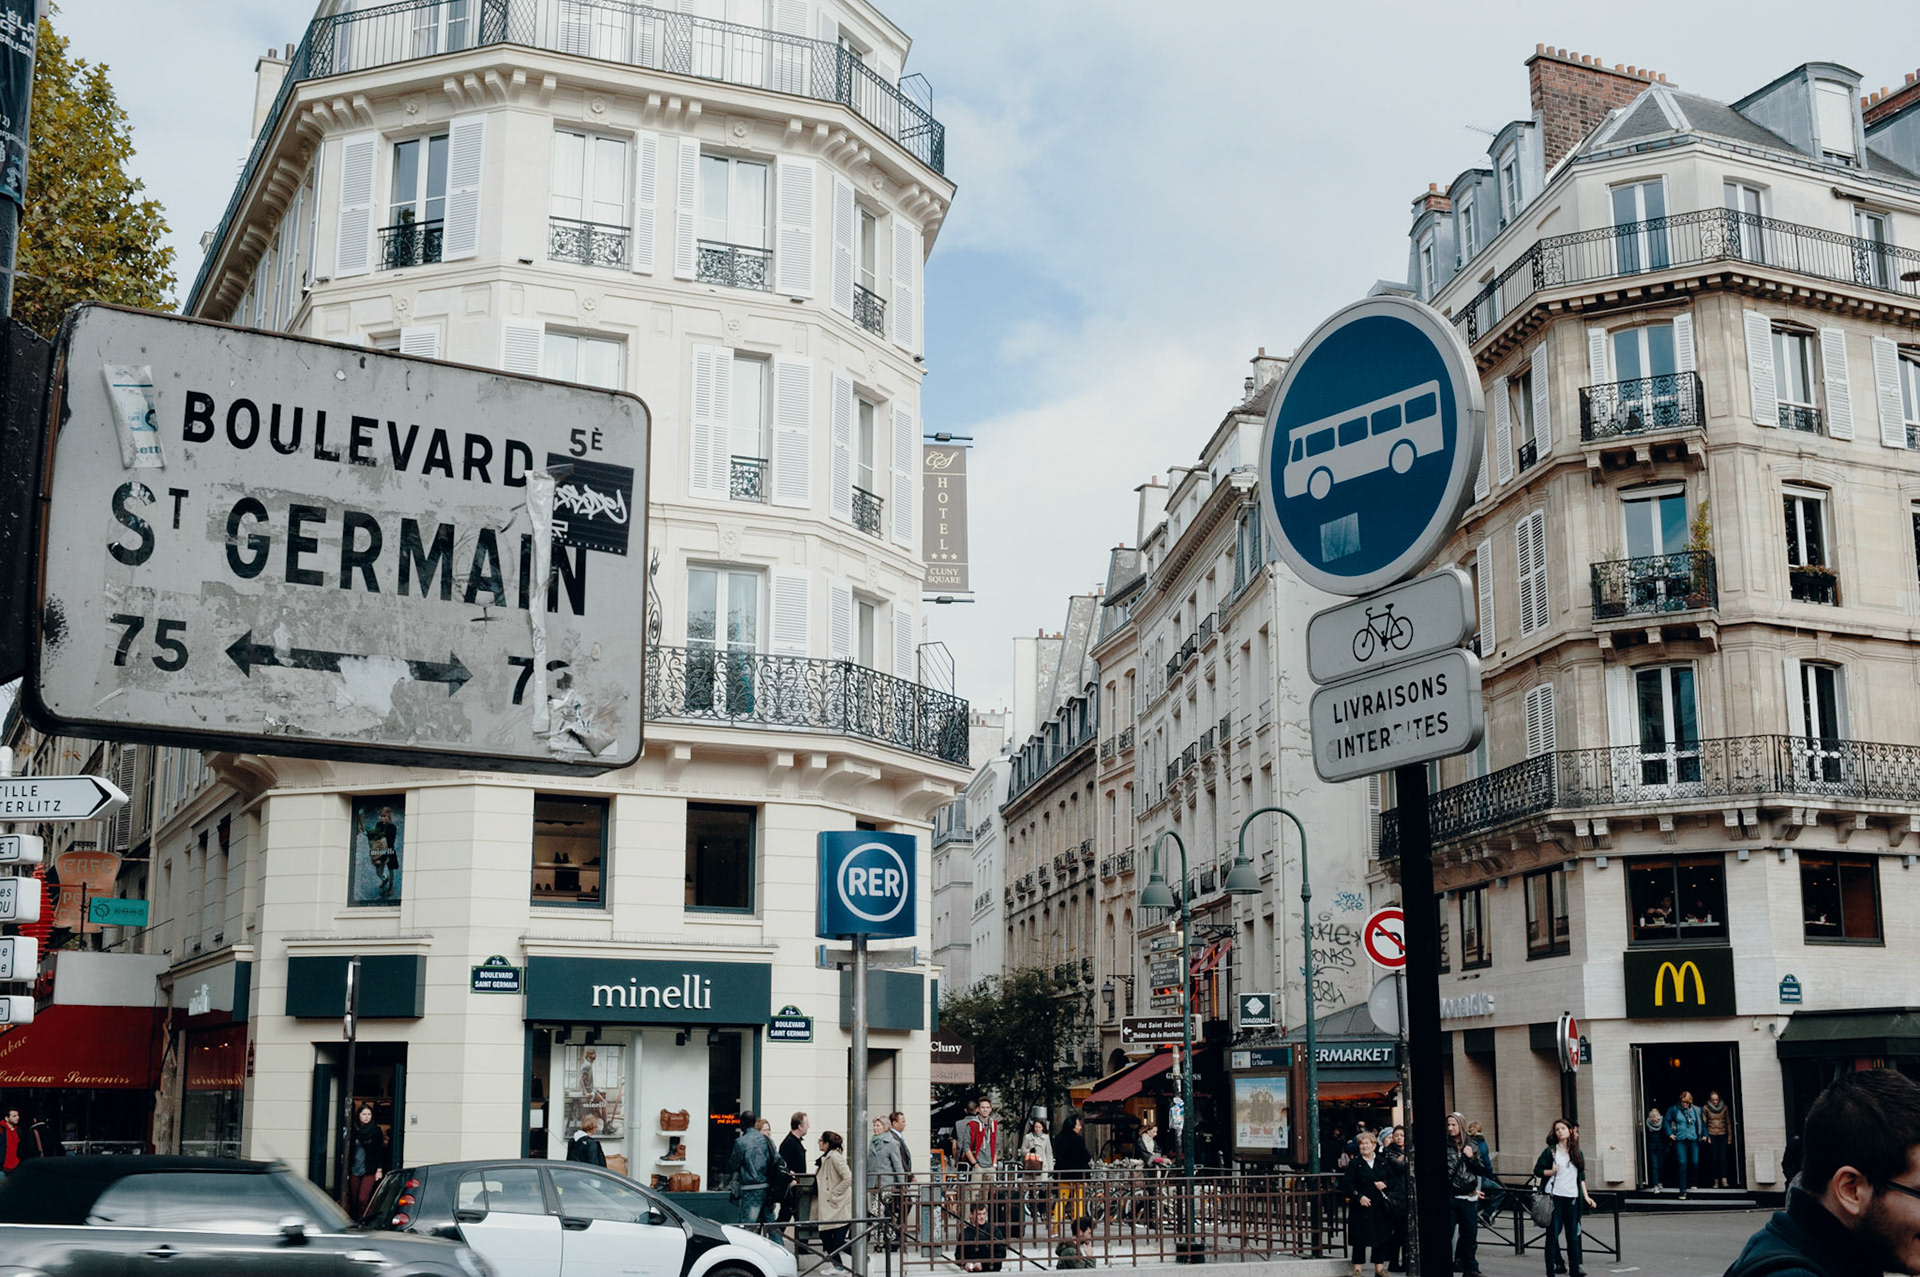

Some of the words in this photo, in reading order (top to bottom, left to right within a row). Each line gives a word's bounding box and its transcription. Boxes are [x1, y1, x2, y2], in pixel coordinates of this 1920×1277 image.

[183, 390, 533, 488] BOULEVARD
[938, 477, 948, 550] HOTEL
[225, 496, 587, 616] GERMAIN
[930, 567, 959, 576] CLUNY
[928, 576, 961, 584] SQUARE
[111, 613, 188, 673] 75
[1333, 673, 1448, 724] LIVRAISONS
[1337, 711, 1449, 759] INTERITES
[848, 867, 900, 898] RER
[480, 971, 513, 979] BOULEVARD
[592, 974, 711, 1009] minelli
[930, 1041, 962, 1054] Cluny
[64, 1071, 130, 1084] Souvenirs
